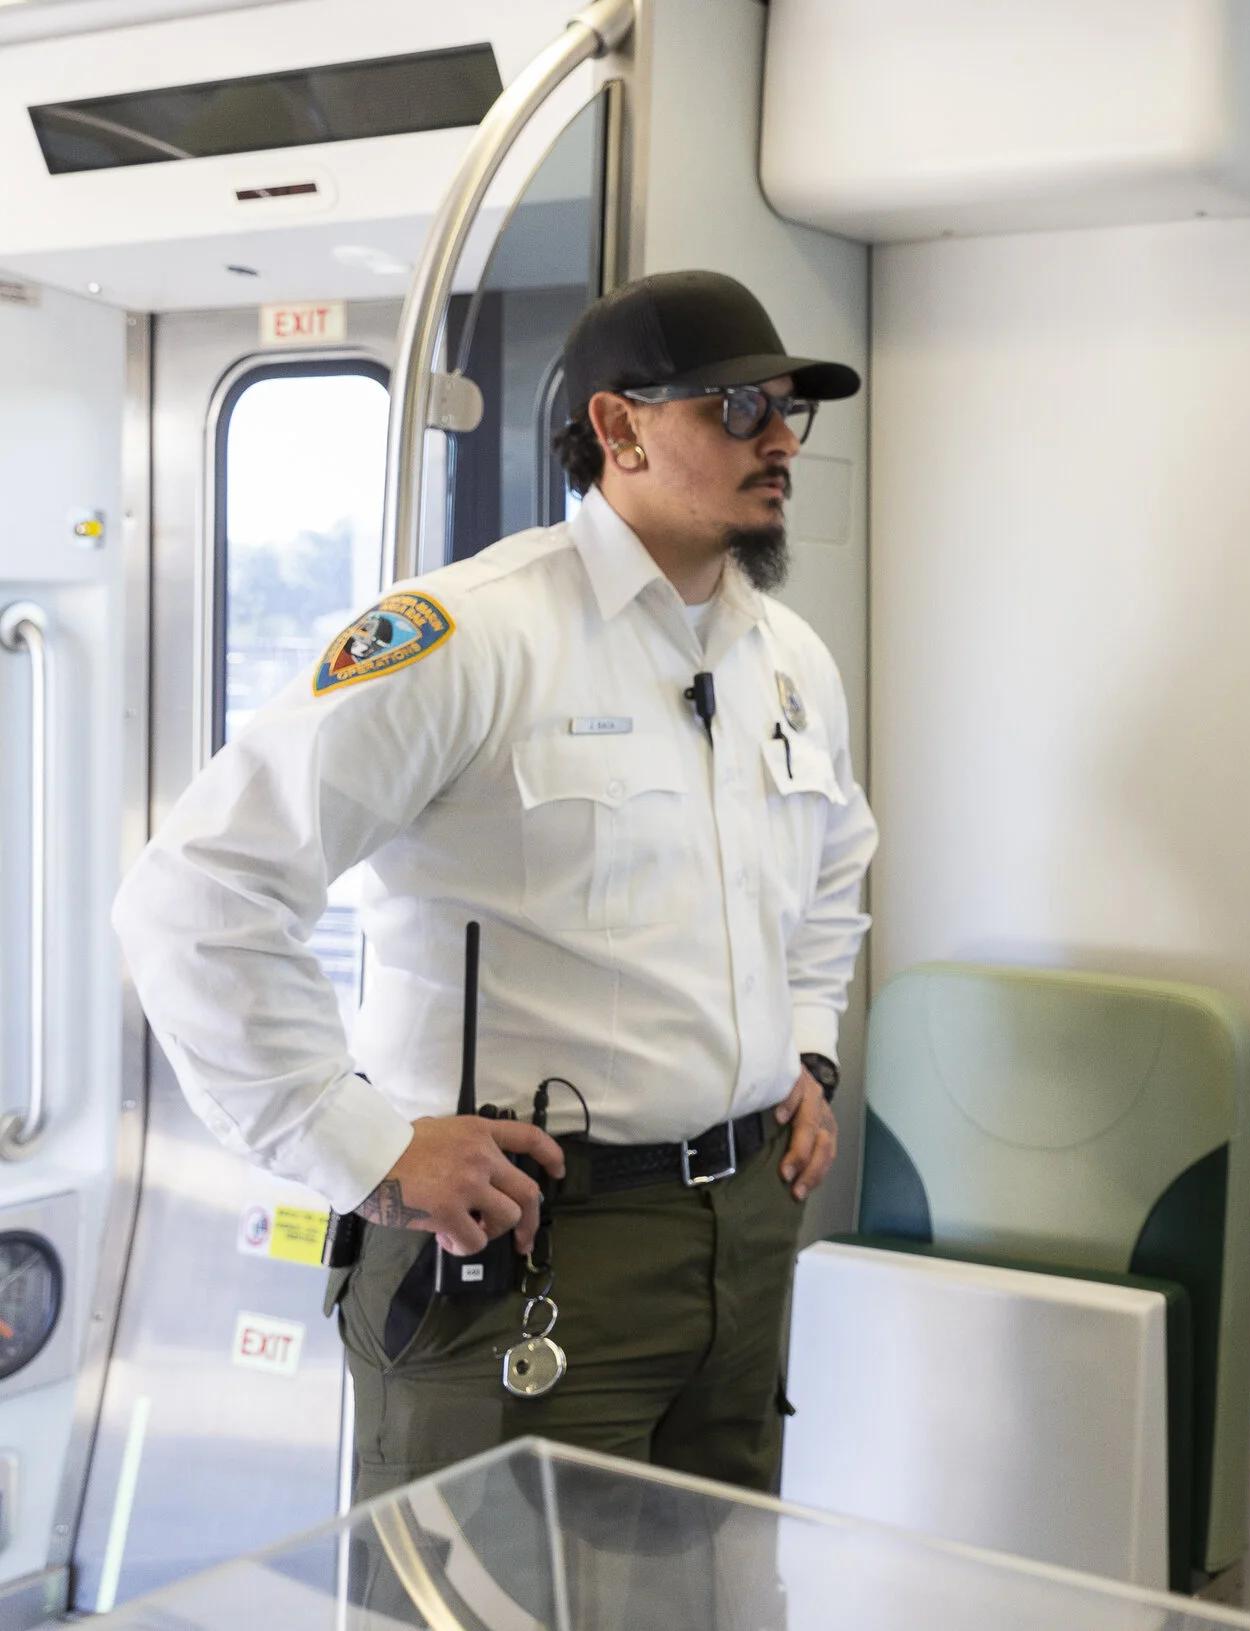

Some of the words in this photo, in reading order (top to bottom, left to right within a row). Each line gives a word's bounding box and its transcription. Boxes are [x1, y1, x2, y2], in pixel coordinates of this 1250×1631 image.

[275, 307, 330, 337] EXIT
[336, 642, 421, 681] OPERATIONS
[241, 1327, 294, 1363] EXIT
